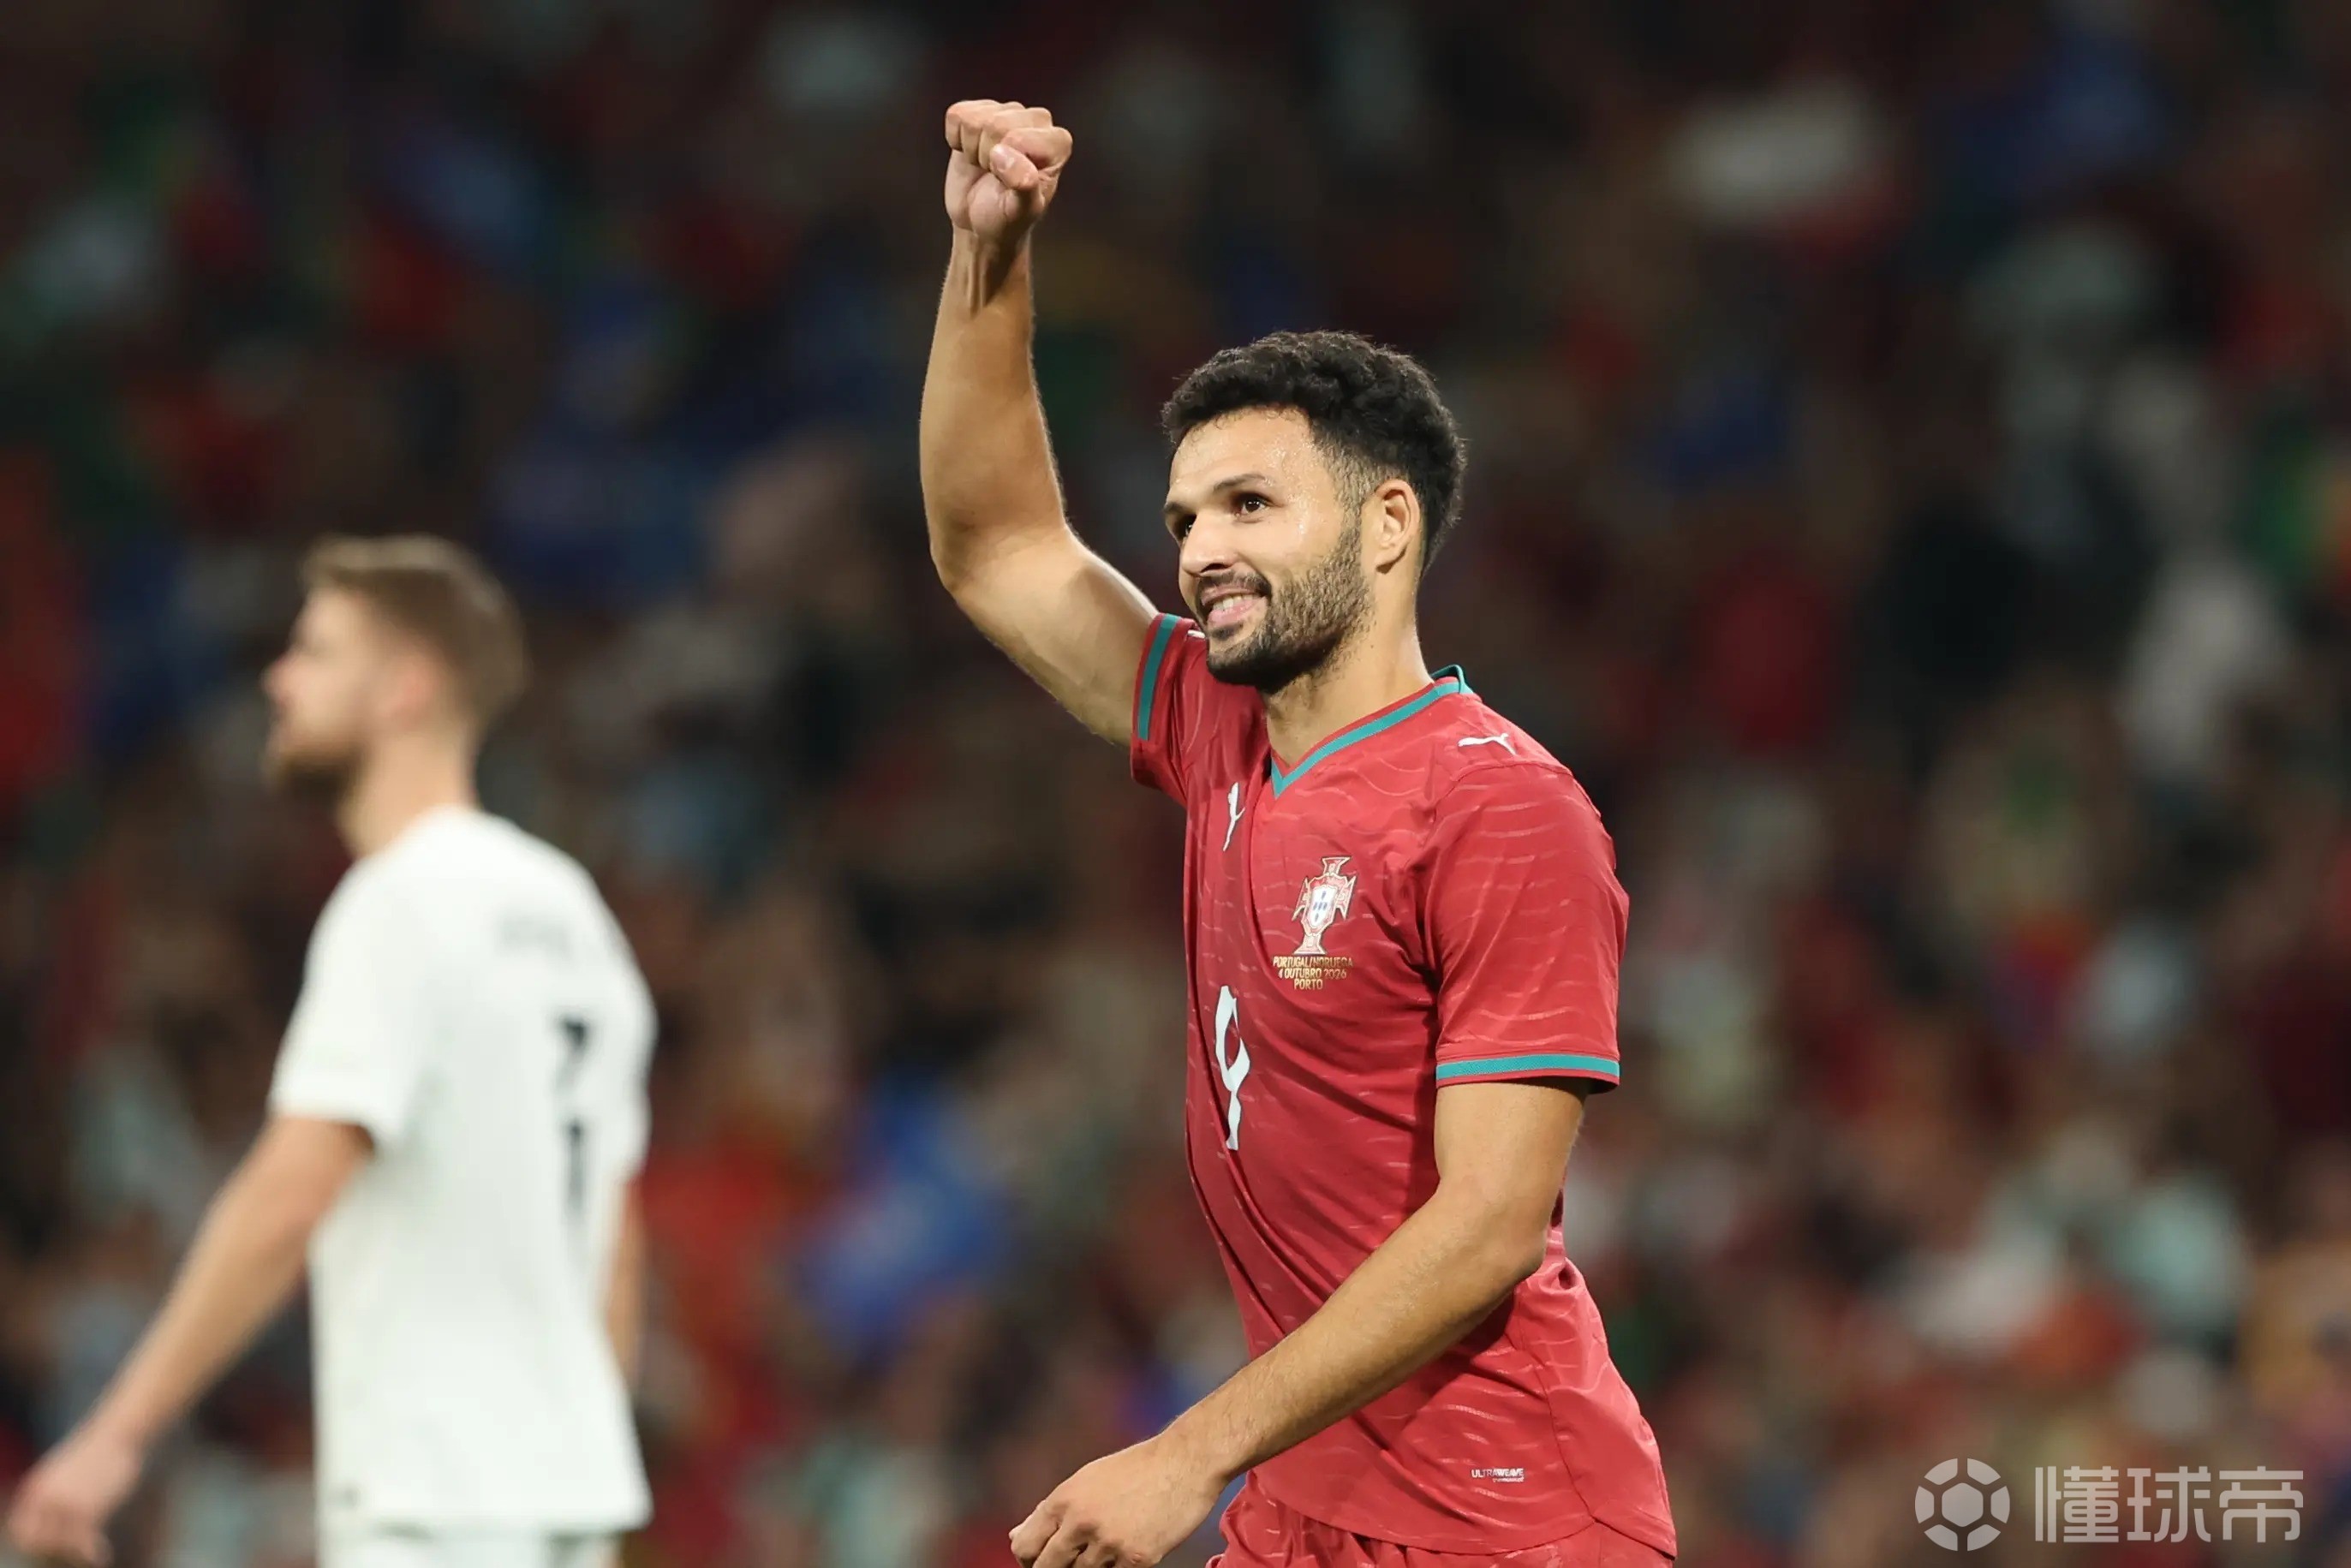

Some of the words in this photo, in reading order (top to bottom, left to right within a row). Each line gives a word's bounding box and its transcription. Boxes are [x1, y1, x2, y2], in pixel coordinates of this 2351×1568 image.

[1273, 956, 1353, 968] PORTUGAL/NORUEGA
[1284, 968, 1322, 979] OUTUBRO
[1323, 969, 1347, 980] 2026
[1294, 979, 1323, 990] PORTO
[1214, 985, 1250, 1151] 9
[1471, 1468, 1524, 1478] ULTRAWEAVE
